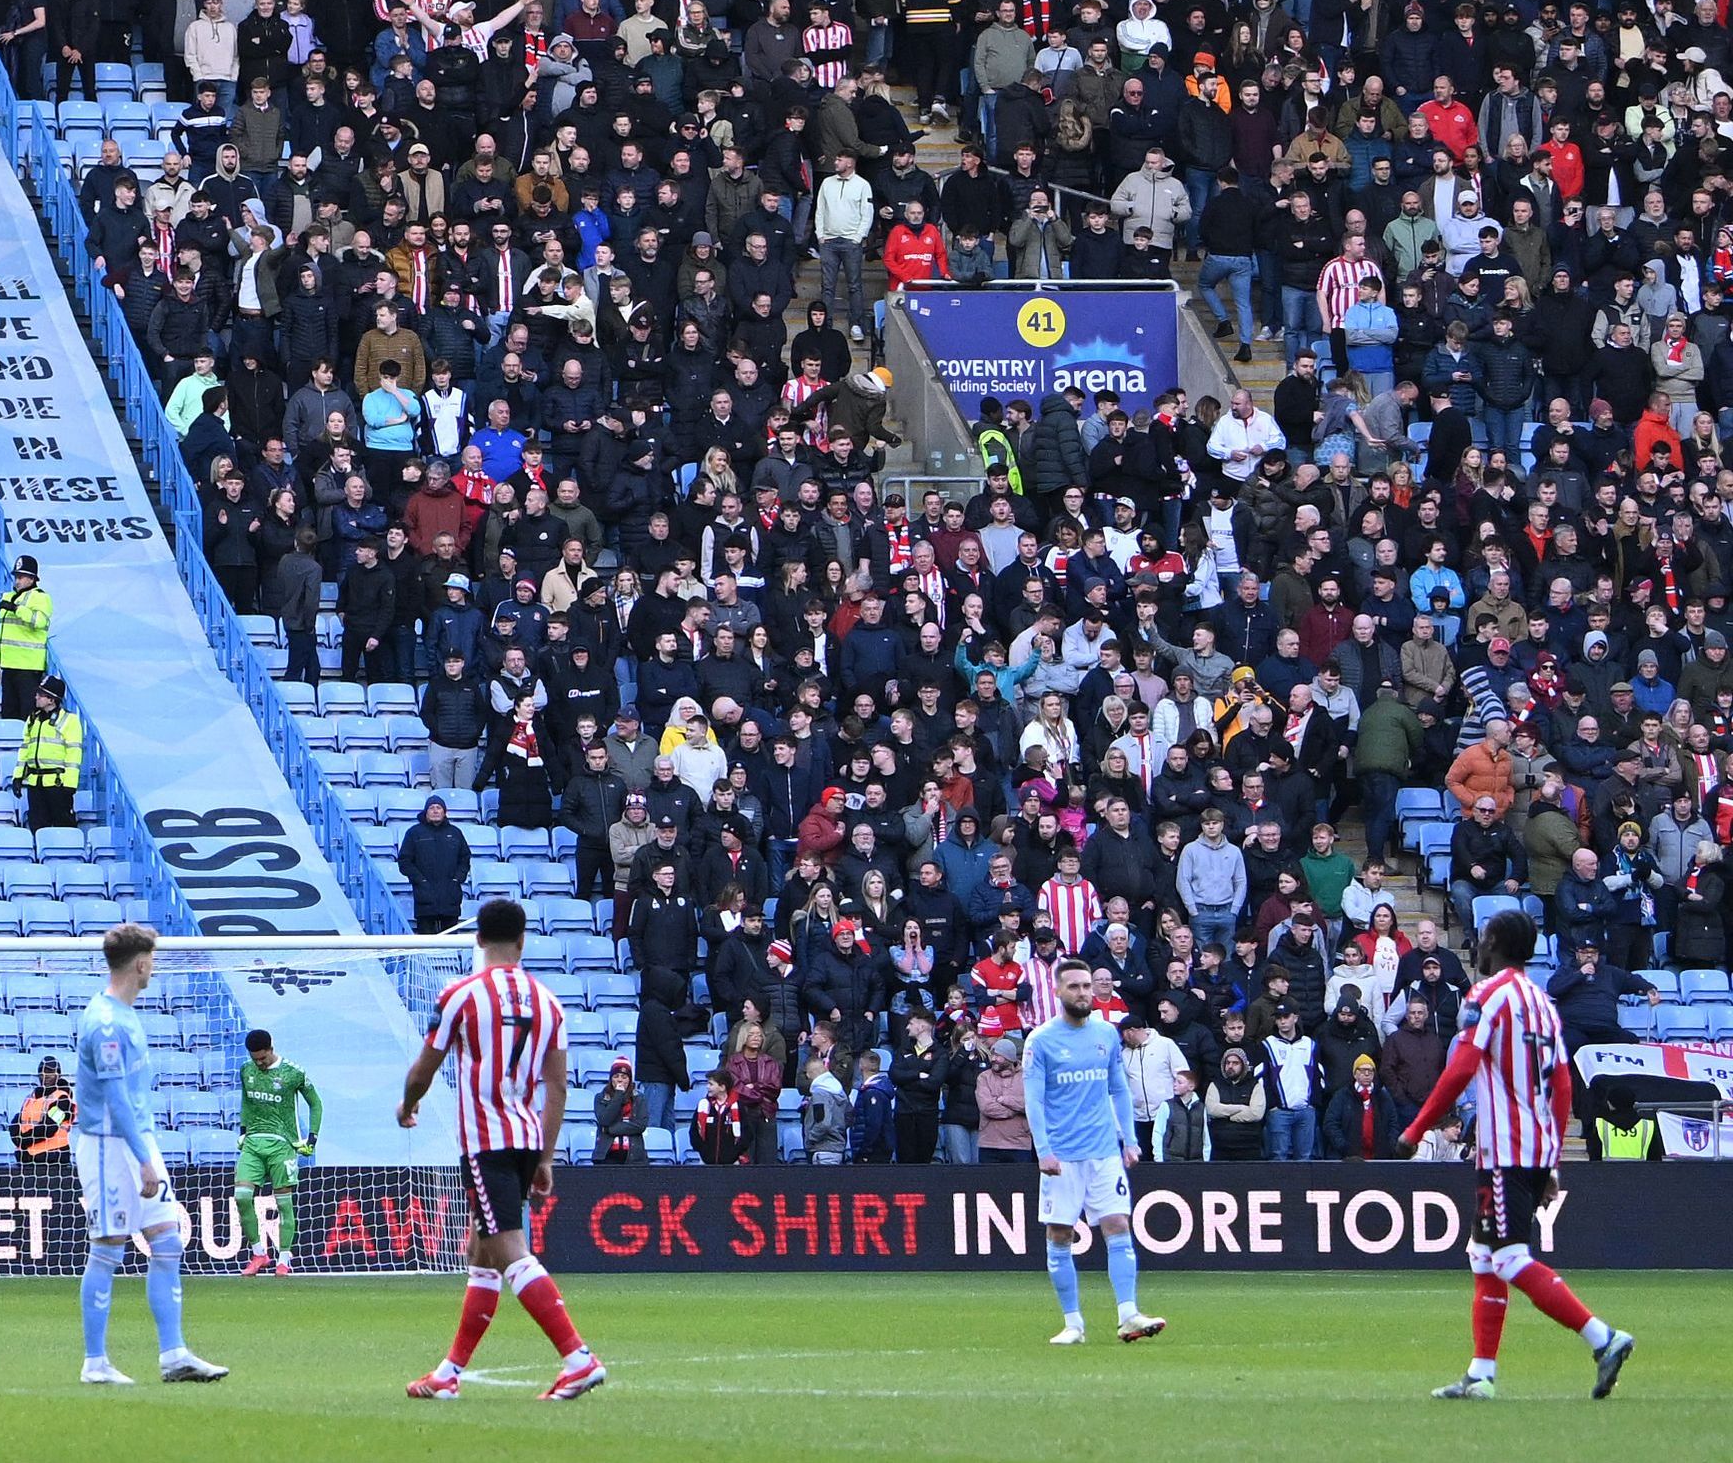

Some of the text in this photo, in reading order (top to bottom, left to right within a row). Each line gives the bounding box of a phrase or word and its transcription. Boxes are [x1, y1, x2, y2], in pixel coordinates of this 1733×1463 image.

[1026, 311, 1057, 333] 41
[990, 380, 1037, 396] Society
[1052, 369, 1147, 393] arena
[12, 436, 64, 461] IN
[4, 516, 154, 545] TOWNS
[501, 1015, 533, 1080] 7
[1595, 1051, 1645, 1067] FTM
[1056, 1068, 1108, 1084] monzo
[247, 1090, 283, 1103] monzo
[1115, 1175, 1127, 1197] 6
[588, 1193, 702, 1256] GK
[728, 1192, 926, 1256] SHIRT
[952, 1192, 1028, 1256] IN
[1305, 1189, 1569, 1254] TODY
